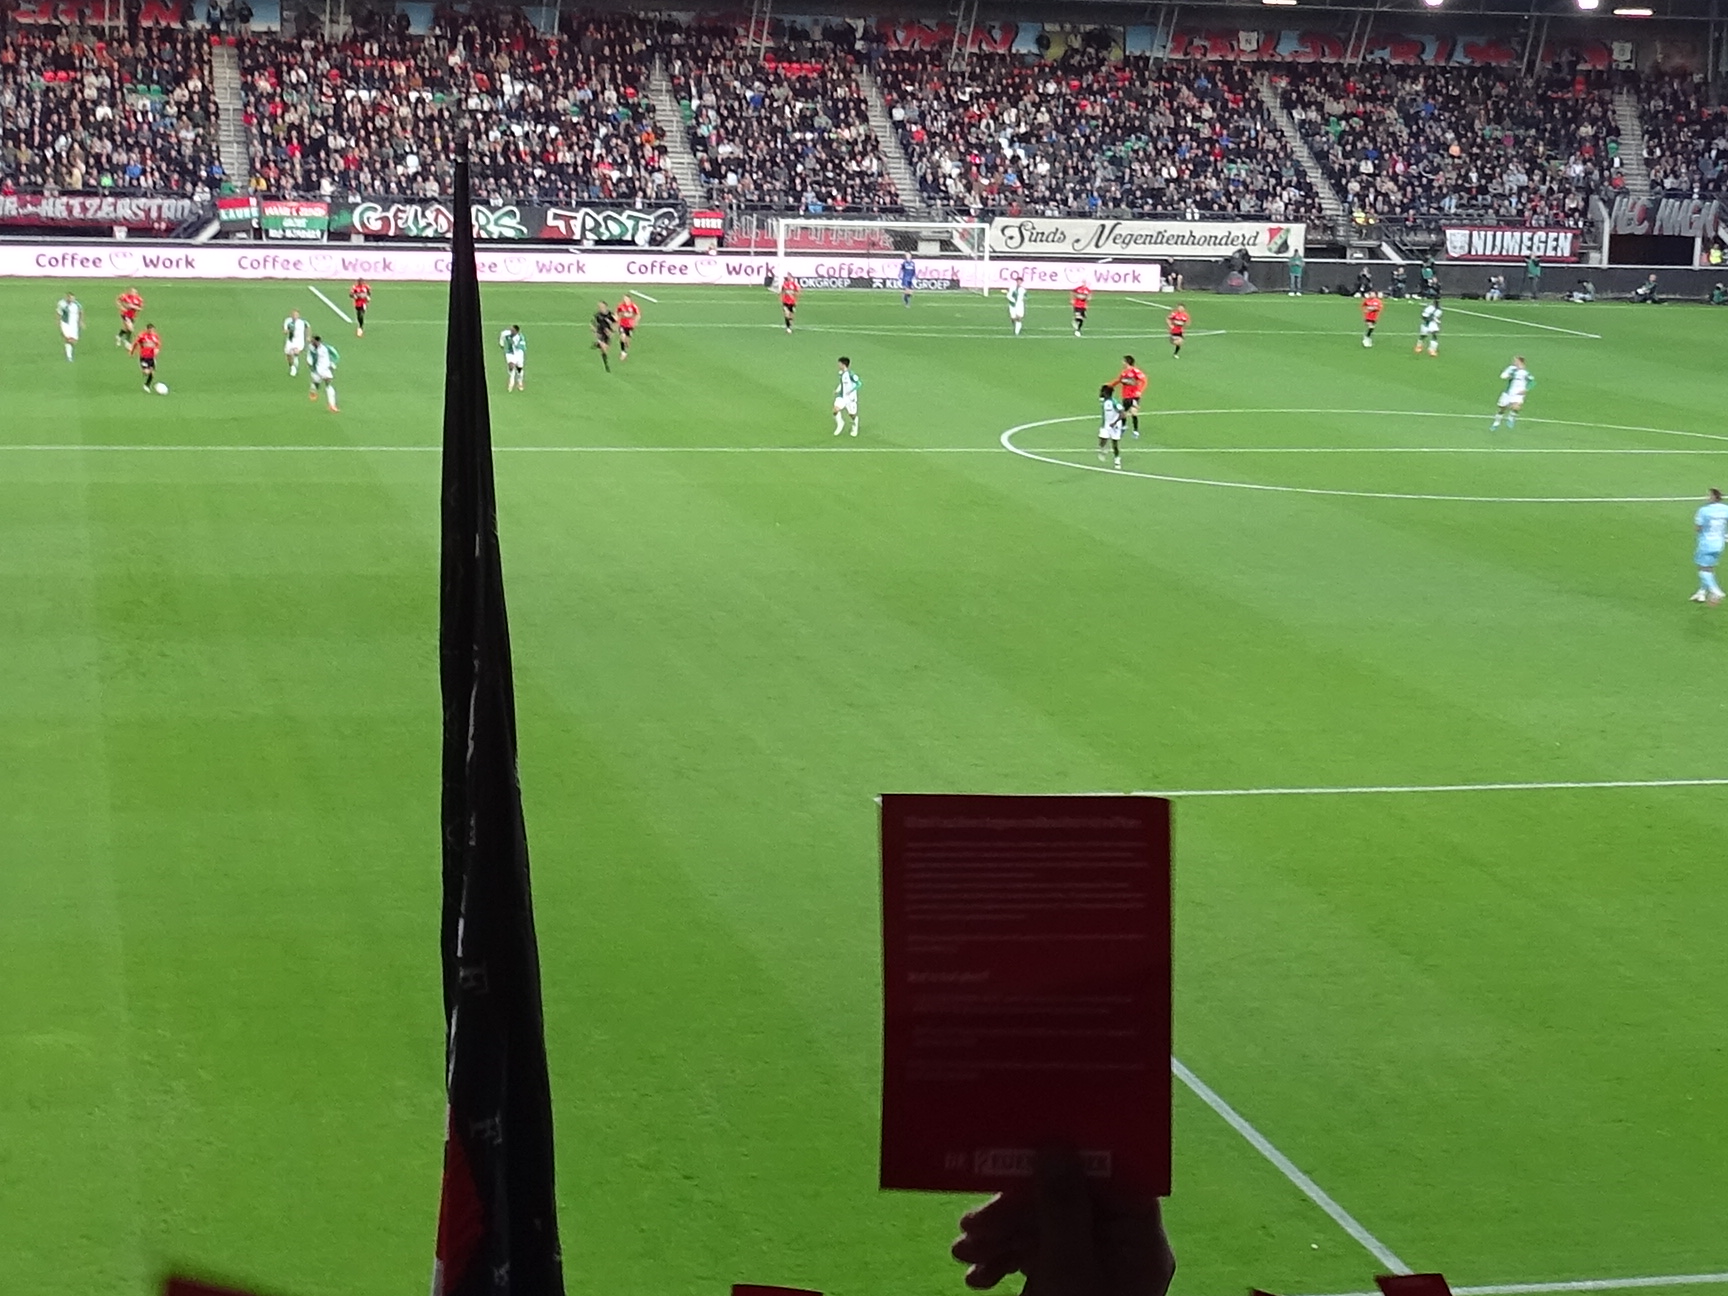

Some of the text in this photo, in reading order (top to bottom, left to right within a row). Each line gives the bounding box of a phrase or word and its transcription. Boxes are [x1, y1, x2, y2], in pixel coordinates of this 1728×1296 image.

[352, 203, 528, 239] GELDRS
[1000, 217, 1261, 255] Sinds Negentienhonderd
[1471, 229, 1574, 257] NIJMEGEN
[35, 252, 103, 269] Coffee
[142, 253, 196, 270] Work
[237, 254, 304, 271] Coffee
[434, 257, 498, 275] Coee
[535, 258, 586, 276] Work
[626, 259, 689, 277] Coffee
[725, 262, 776, 278] Work
[815, 262, 877, 279] Coffee
[998, 266, 1060, 284] Coffee
[1093, 267, 1142, 285] Work
[794, 277, 852, 290] LOKGROEP
